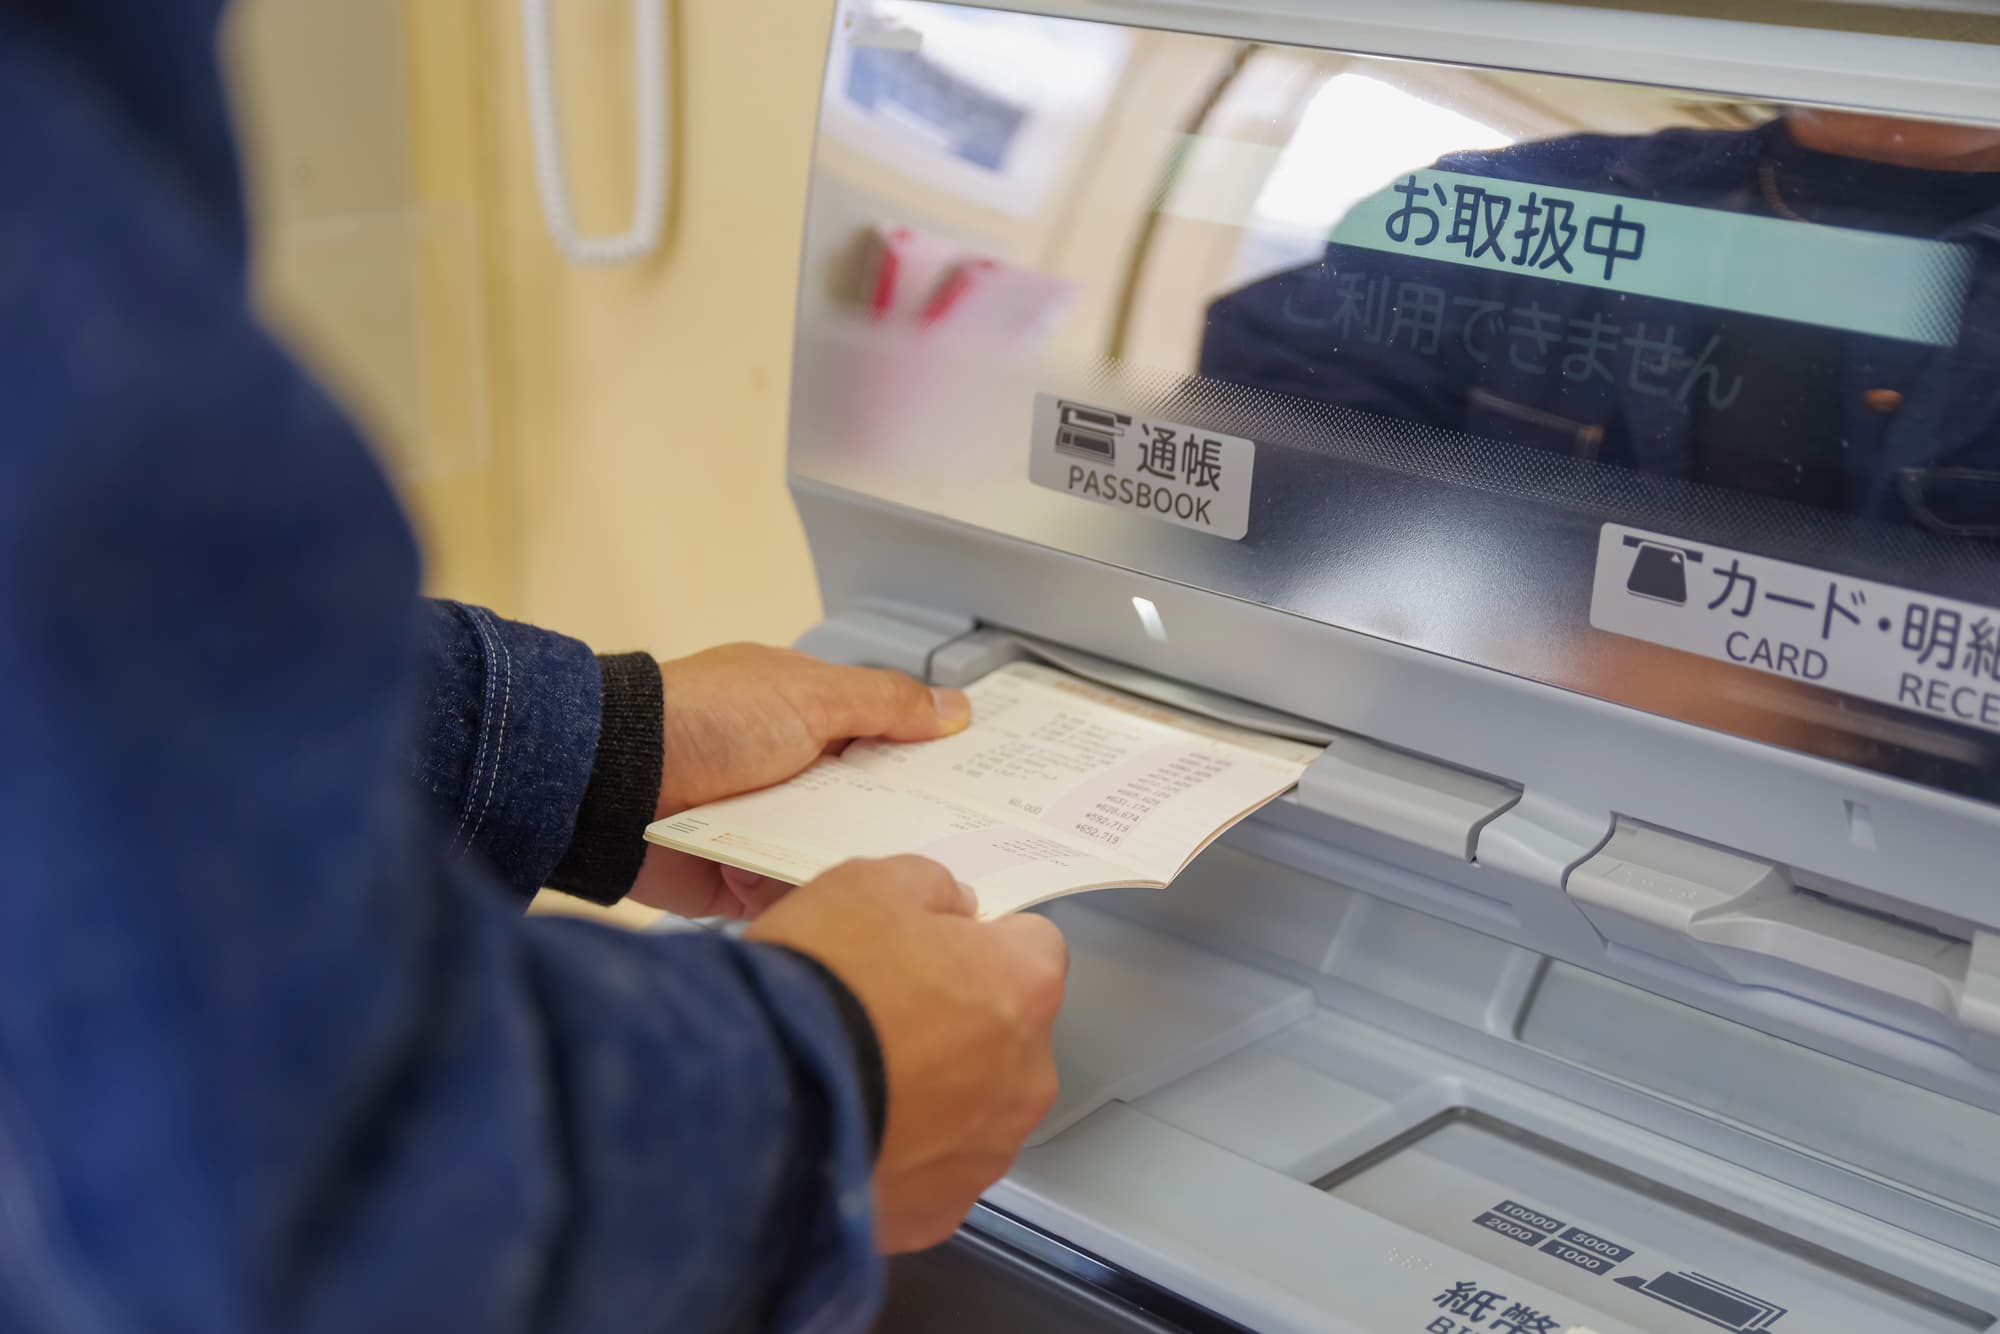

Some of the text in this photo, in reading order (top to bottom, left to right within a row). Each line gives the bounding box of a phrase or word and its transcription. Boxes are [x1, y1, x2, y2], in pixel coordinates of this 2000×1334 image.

[1384, 174, 1646, 281] お取扱中
[1136, 422, 1223, 492] 通帳
[1068, 464, 1212, 525] PASSBOOK
[1725, 630, 1829, 681] CARD
[1485, 1217, 1601, 1270] 2000 1000
[1502, 1203, 1621, 1257] 10000 5000
